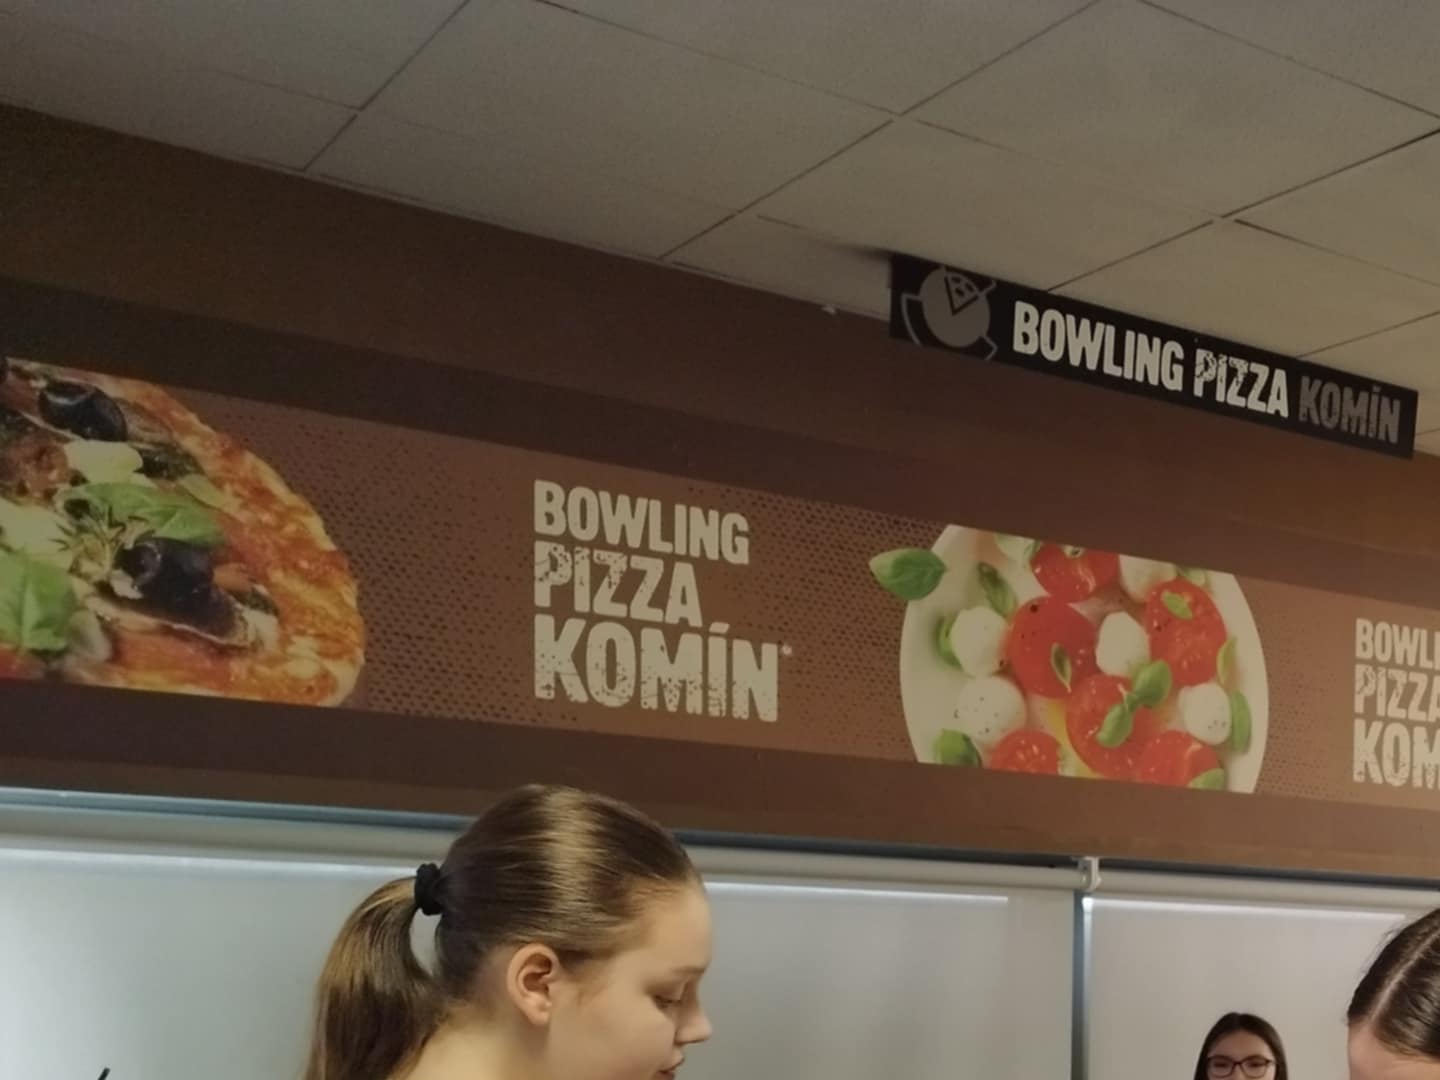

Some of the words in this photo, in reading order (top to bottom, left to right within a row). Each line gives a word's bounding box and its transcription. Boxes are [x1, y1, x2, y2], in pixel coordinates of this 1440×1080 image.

[1012, 300, 1184, 392] BOWLING
[1193, 348, 1290, 419] PIZZA
[1299, 375, 1401, 444] KOMÍN
[534, 479, 750, 566] BOWLING
[534, 540, 703, 628] PIZZA
[534, 613, 779, 722] KOMÍN
